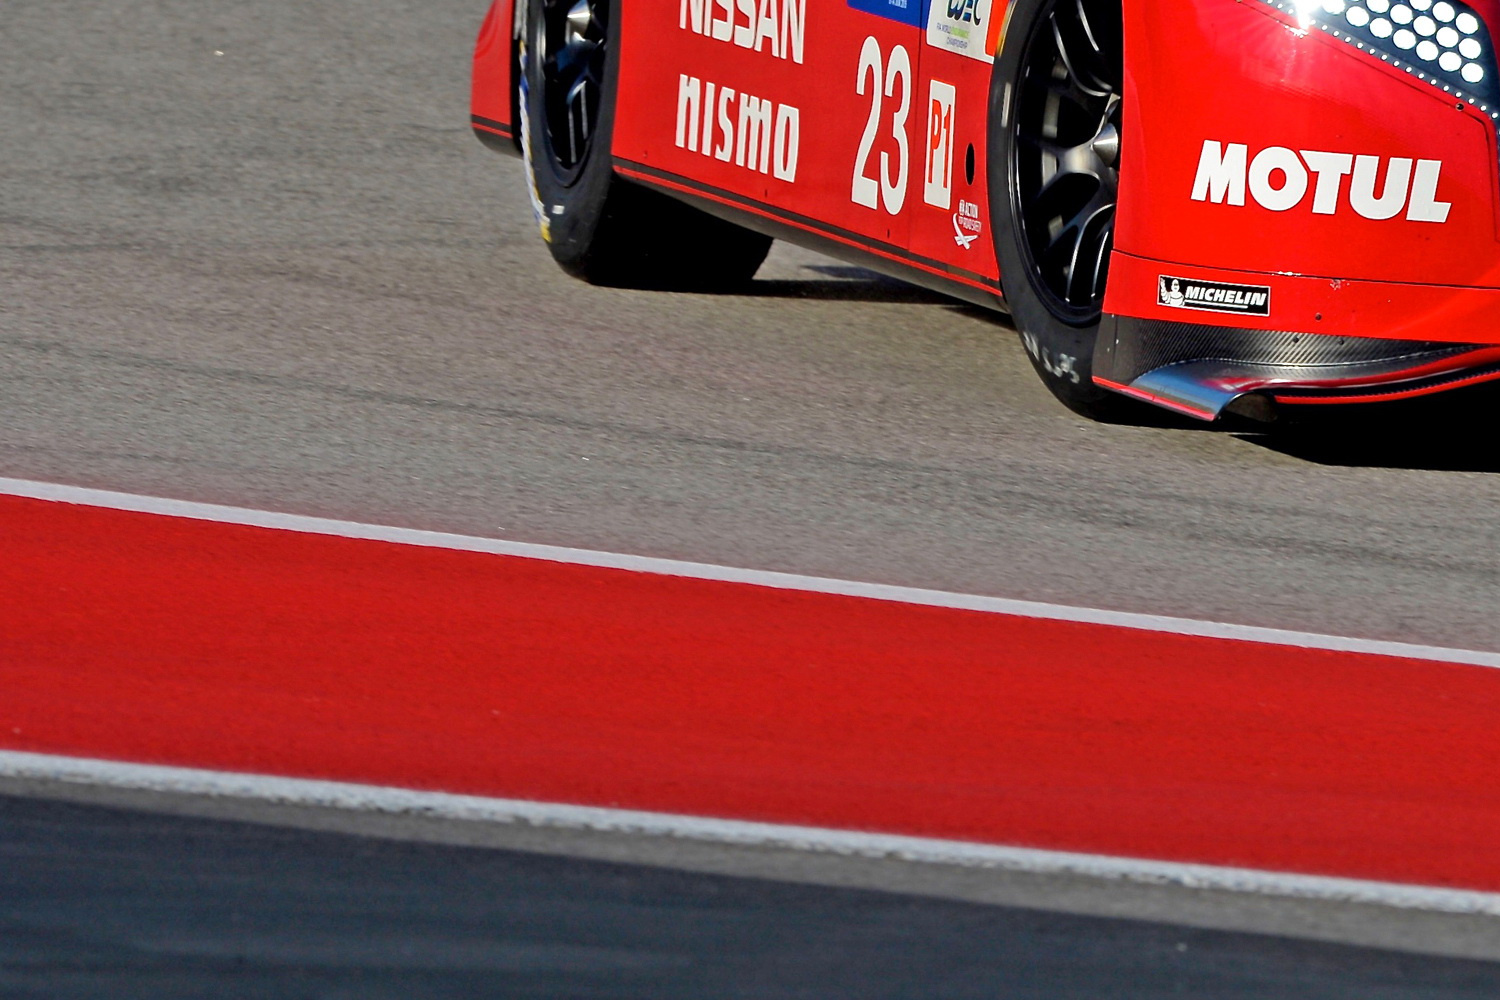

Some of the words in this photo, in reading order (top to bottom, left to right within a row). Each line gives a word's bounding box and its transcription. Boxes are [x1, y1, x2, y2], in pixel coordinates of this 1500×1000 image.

[851, 36, 912, 215] 23
[927, 98, 952, 190] P1
[1190, 139, 1452, 223] MOTUL
[1185, 285, 1267, 306] MICHELIN
